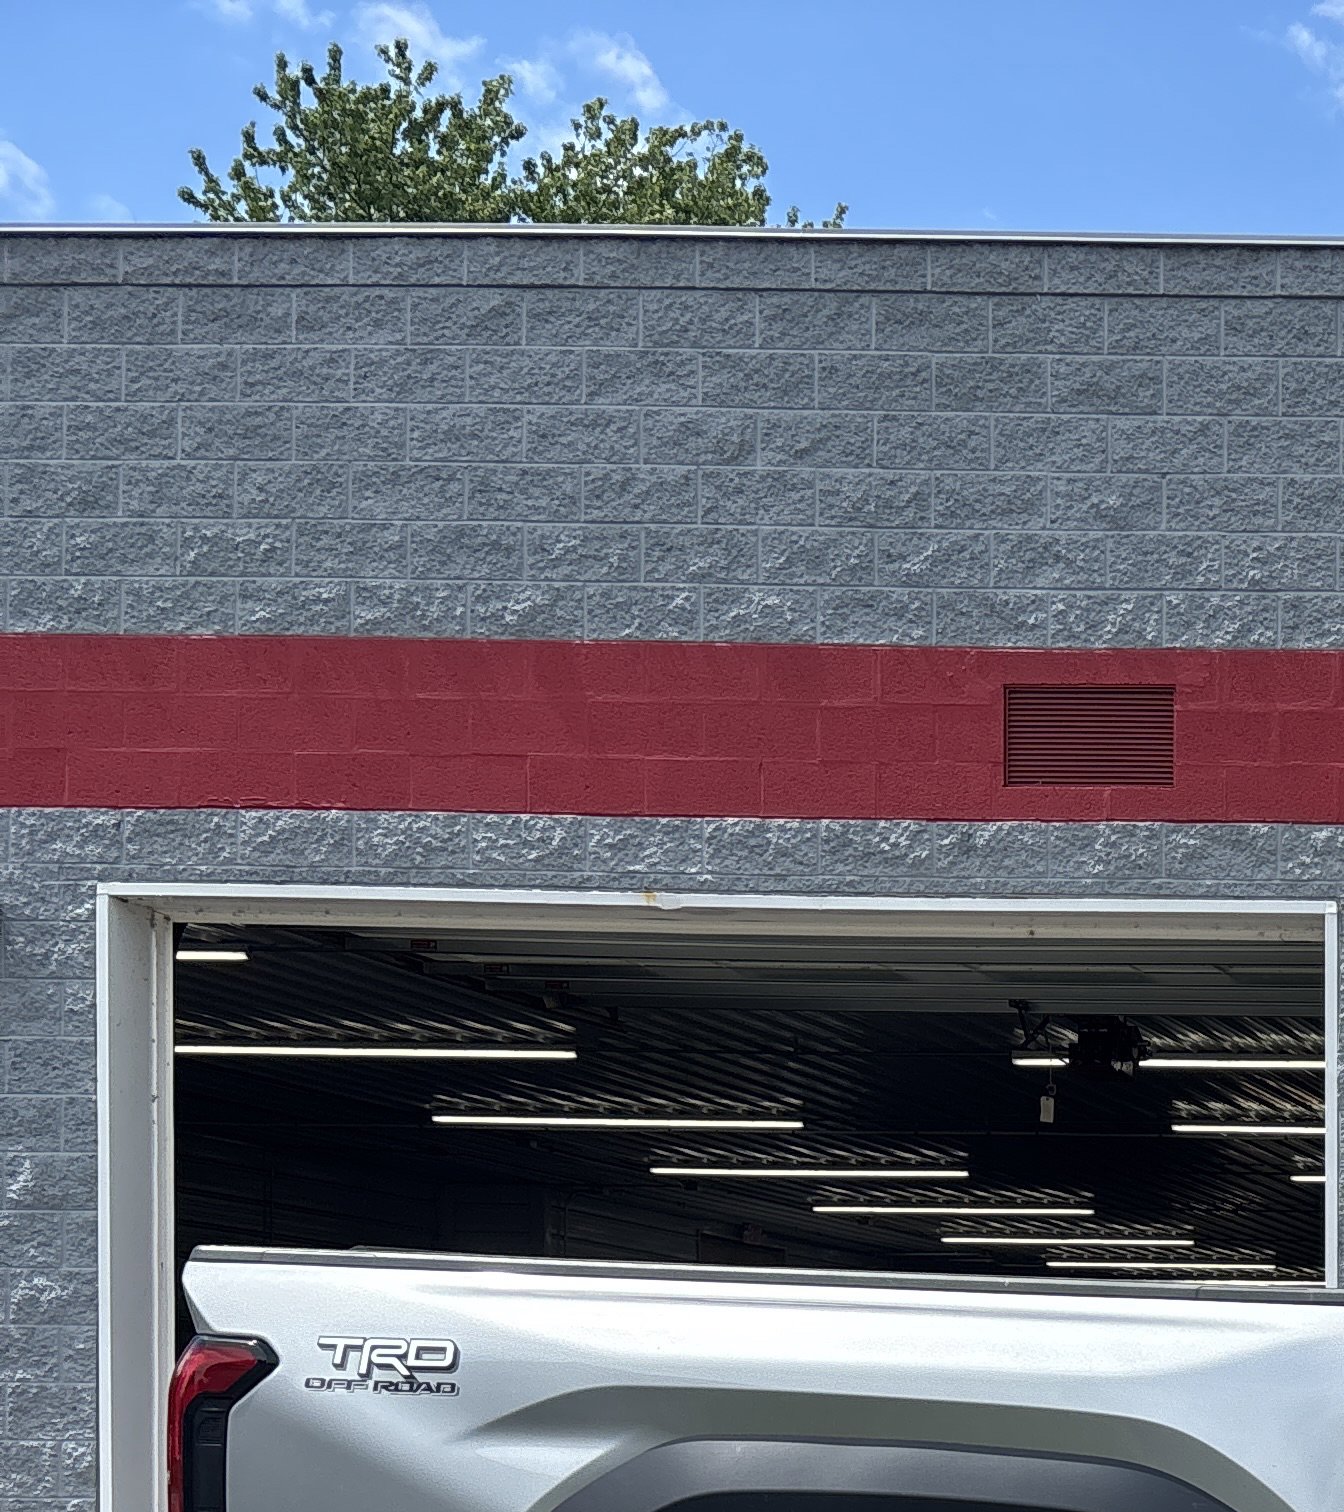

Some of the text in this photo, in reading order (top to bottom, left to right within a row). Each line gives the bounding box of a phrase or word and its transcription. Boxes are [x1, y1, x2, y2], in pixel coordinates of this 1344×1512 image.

[317, 1335, 460, 1382] TRD
[304, 1377, 460, 1396] OFF ROAD
